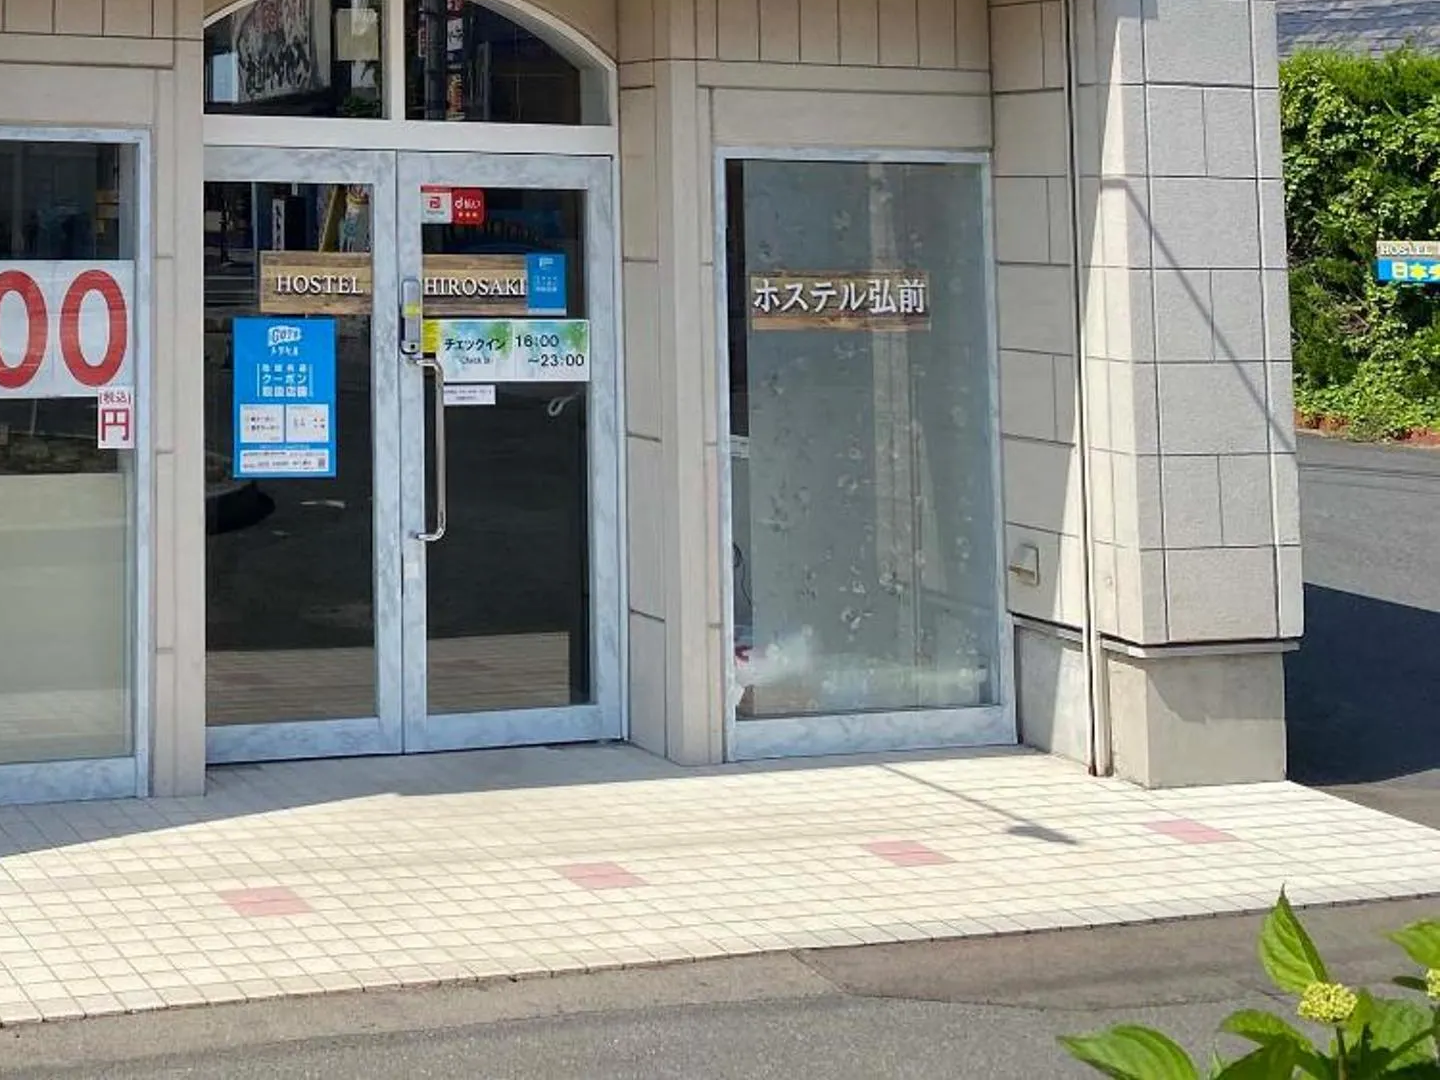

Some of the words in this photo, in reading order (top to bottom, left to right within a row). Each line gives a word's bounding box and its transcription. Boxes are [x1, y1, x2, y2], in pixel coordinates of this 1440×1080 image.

[275, 274, 364, 295] HOSTEL
[424, 277, 526, 296] HIROSAKI
[754, 278, 926, 314] ホステル弘前
[444, 337, 506, 352] チェックイン
[261, 374, 307, 385] クーポン
[101, 408, 130, 442] 円
